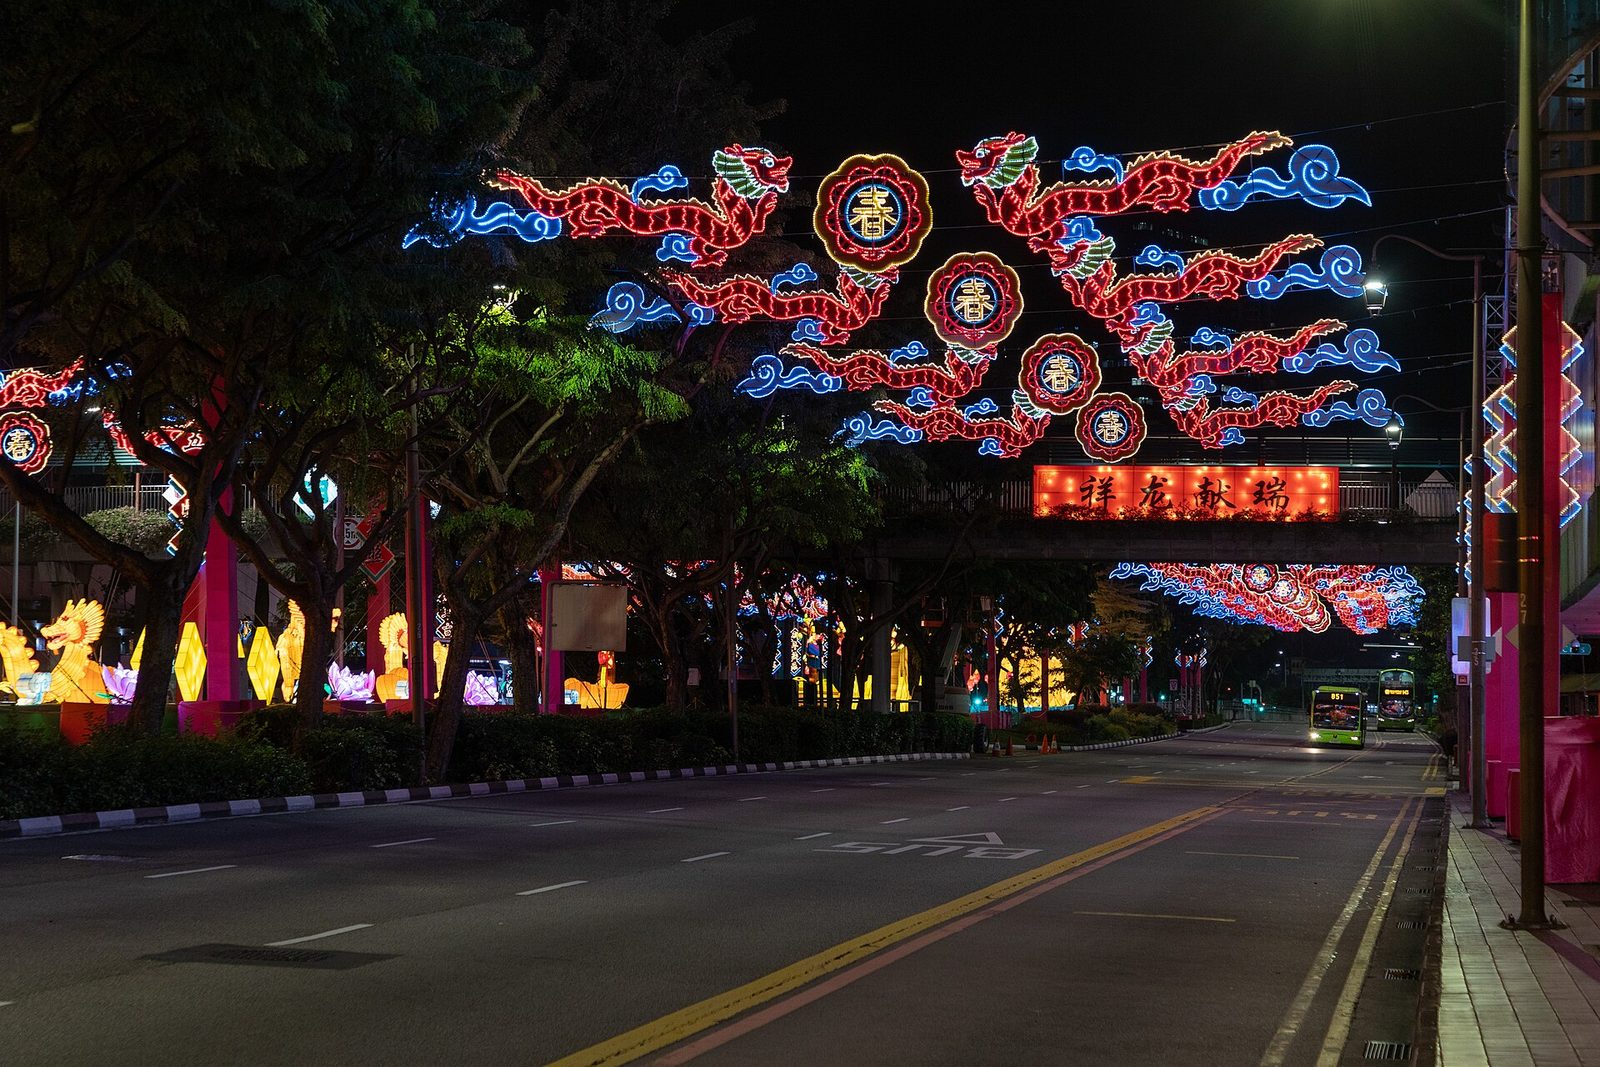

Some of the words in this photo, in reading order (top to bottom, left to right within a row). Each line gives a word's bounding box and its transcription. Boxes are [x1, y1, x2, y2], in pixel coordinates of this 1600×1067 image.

[849, 186, 898, 238] 春
[954, 278, 994, 321] 春
[1042, 355, 1078, 391] 春
[1096, 410, 1125, 442] 春
[7, 430, 32, 458] 春
[1079, 475, 1290, 511] 祥龙献瑞
[1519, 593, 1527, 624] 27
[813, 841, 1045, 860] BUS
